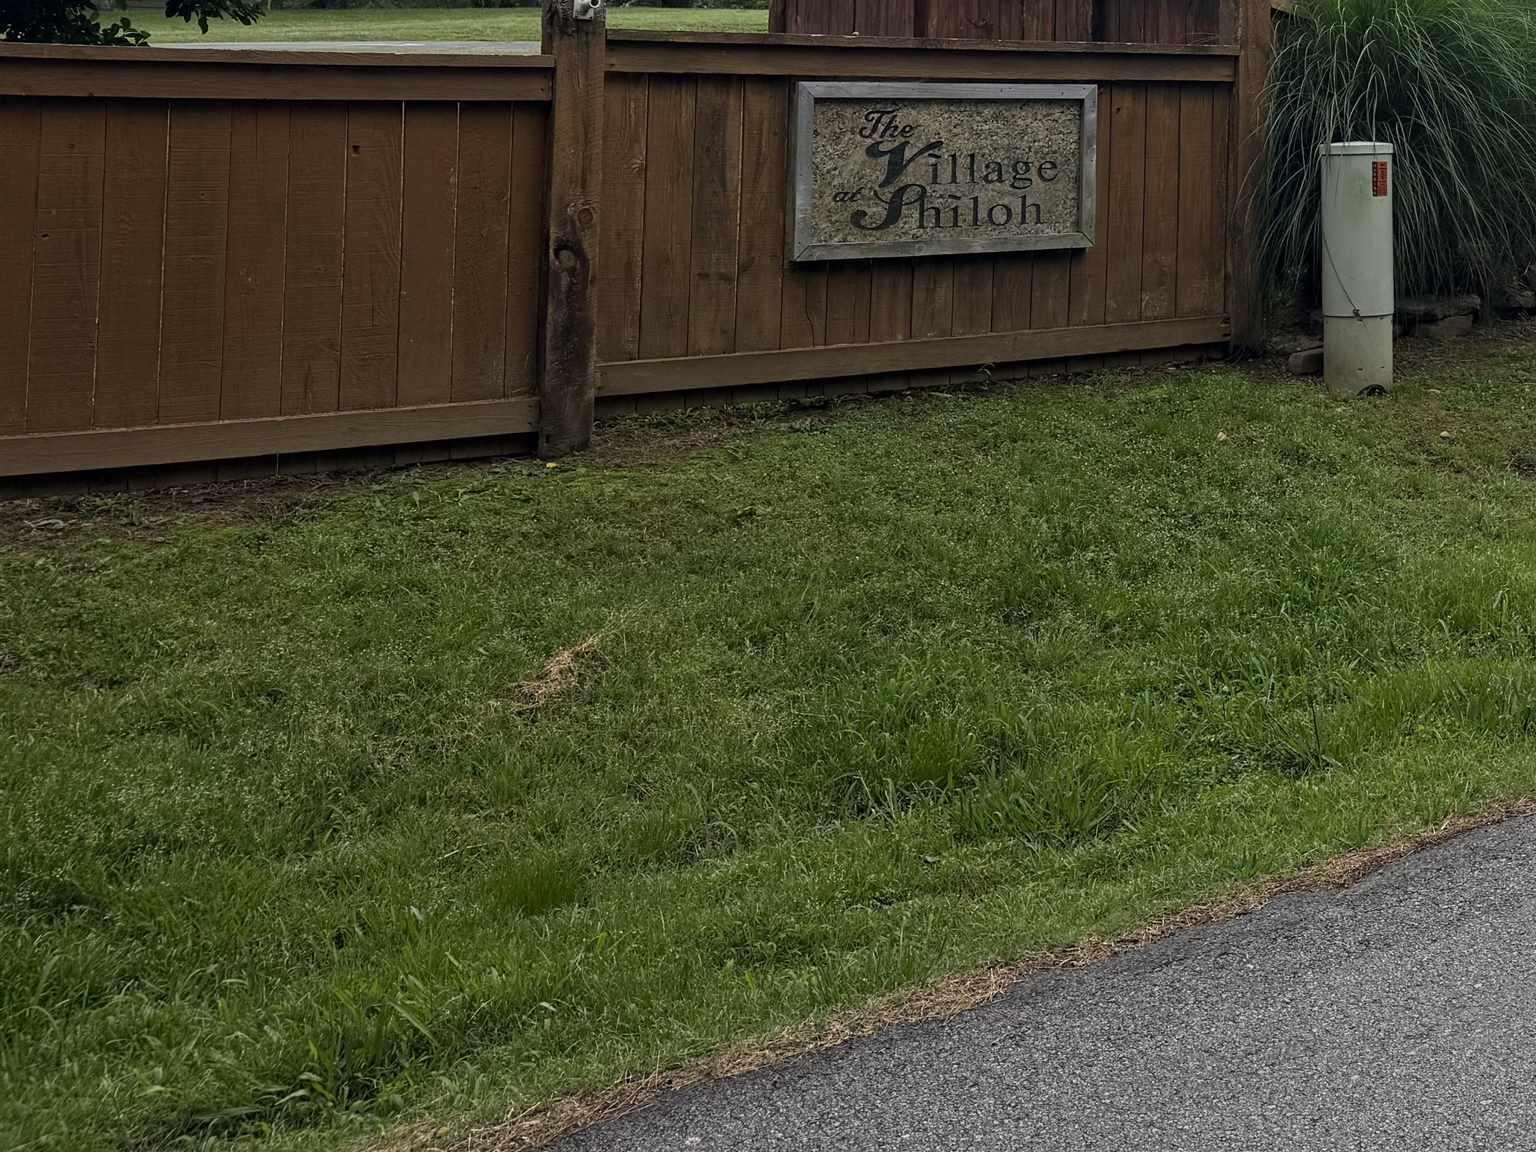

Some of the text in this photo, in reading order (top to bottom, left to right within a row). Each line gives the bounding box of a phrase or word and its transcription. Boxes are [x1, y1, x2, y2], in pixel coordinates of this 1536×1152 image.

[859, 110, 915, 139] The
[866, 140, 1058, 189] Village
[832, 183, 1043, 230] at Shiloh
